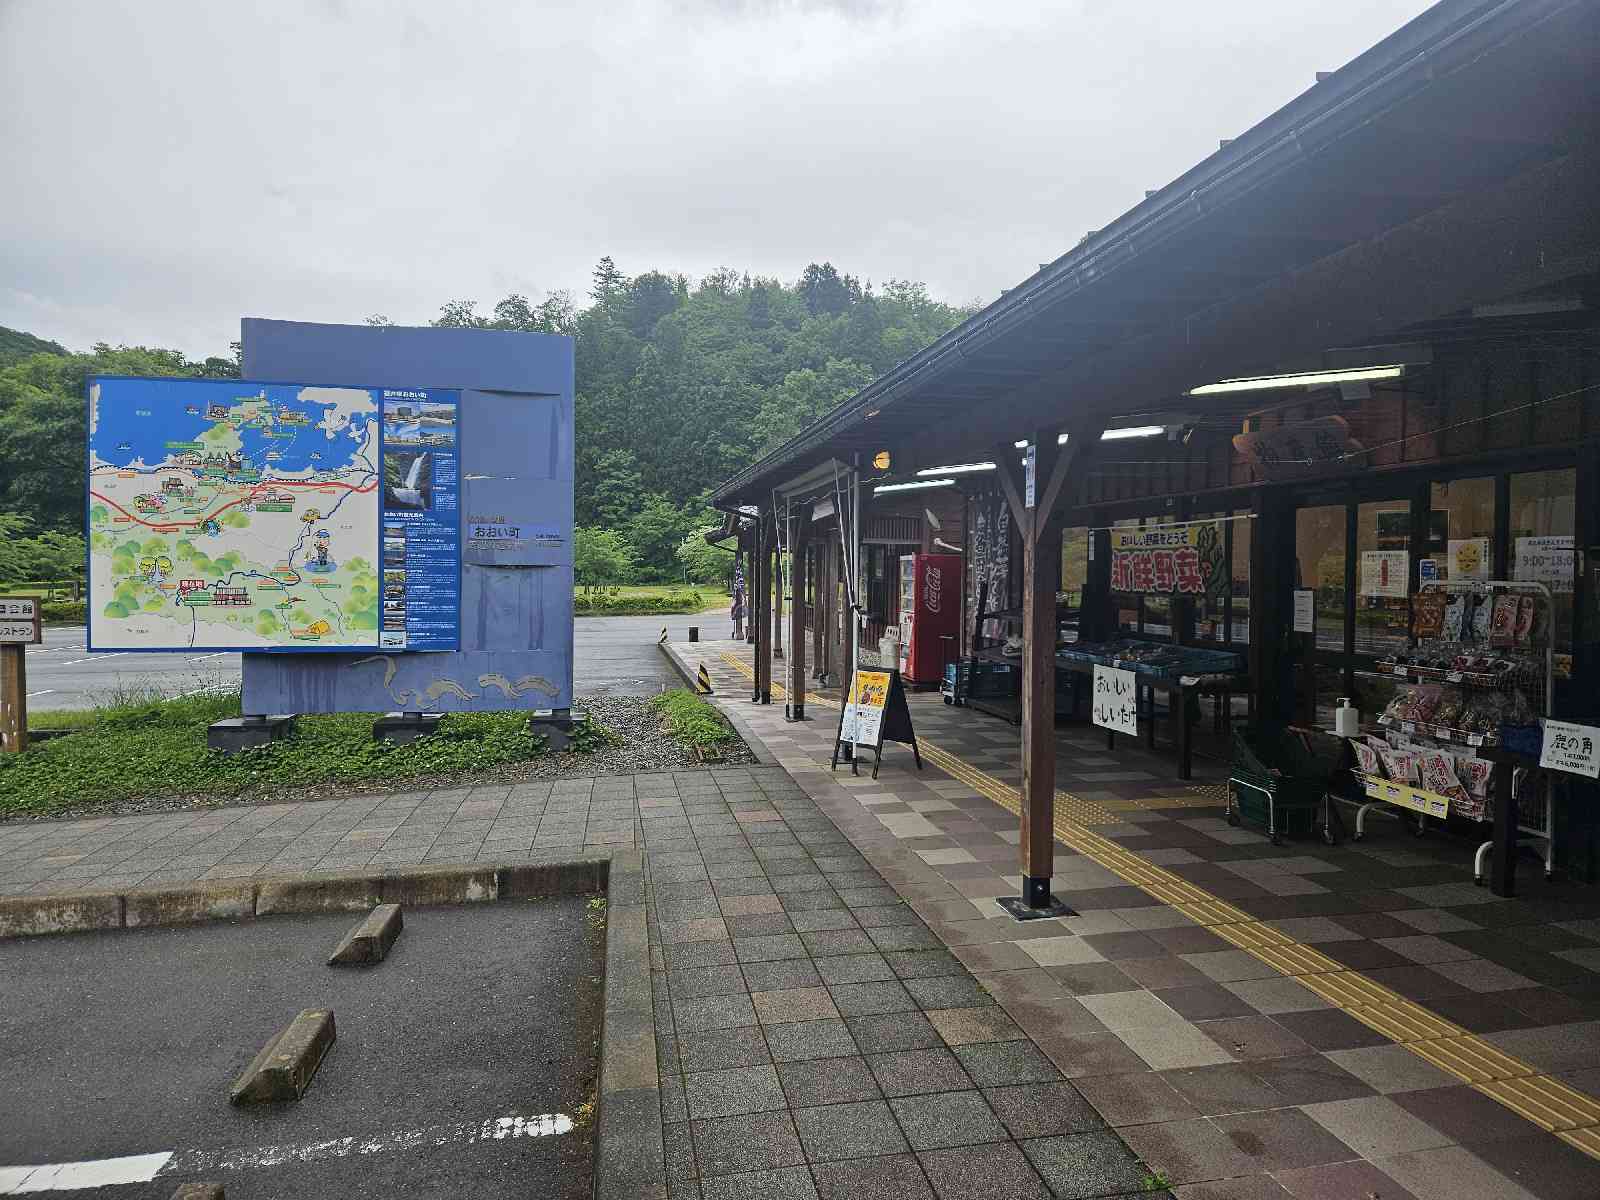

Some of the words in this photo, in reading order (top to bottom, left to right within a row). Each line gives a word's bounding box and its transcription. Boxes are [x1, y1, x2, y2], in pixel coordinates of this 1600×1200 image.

[1111, 549, 1204, 592] 新鮮野菜
[1097, 674, 1130, 695] おいしい
[1101, 703, 1136, 726] しいたけ
[1550, 734, 1592, 754] 鹿の角
